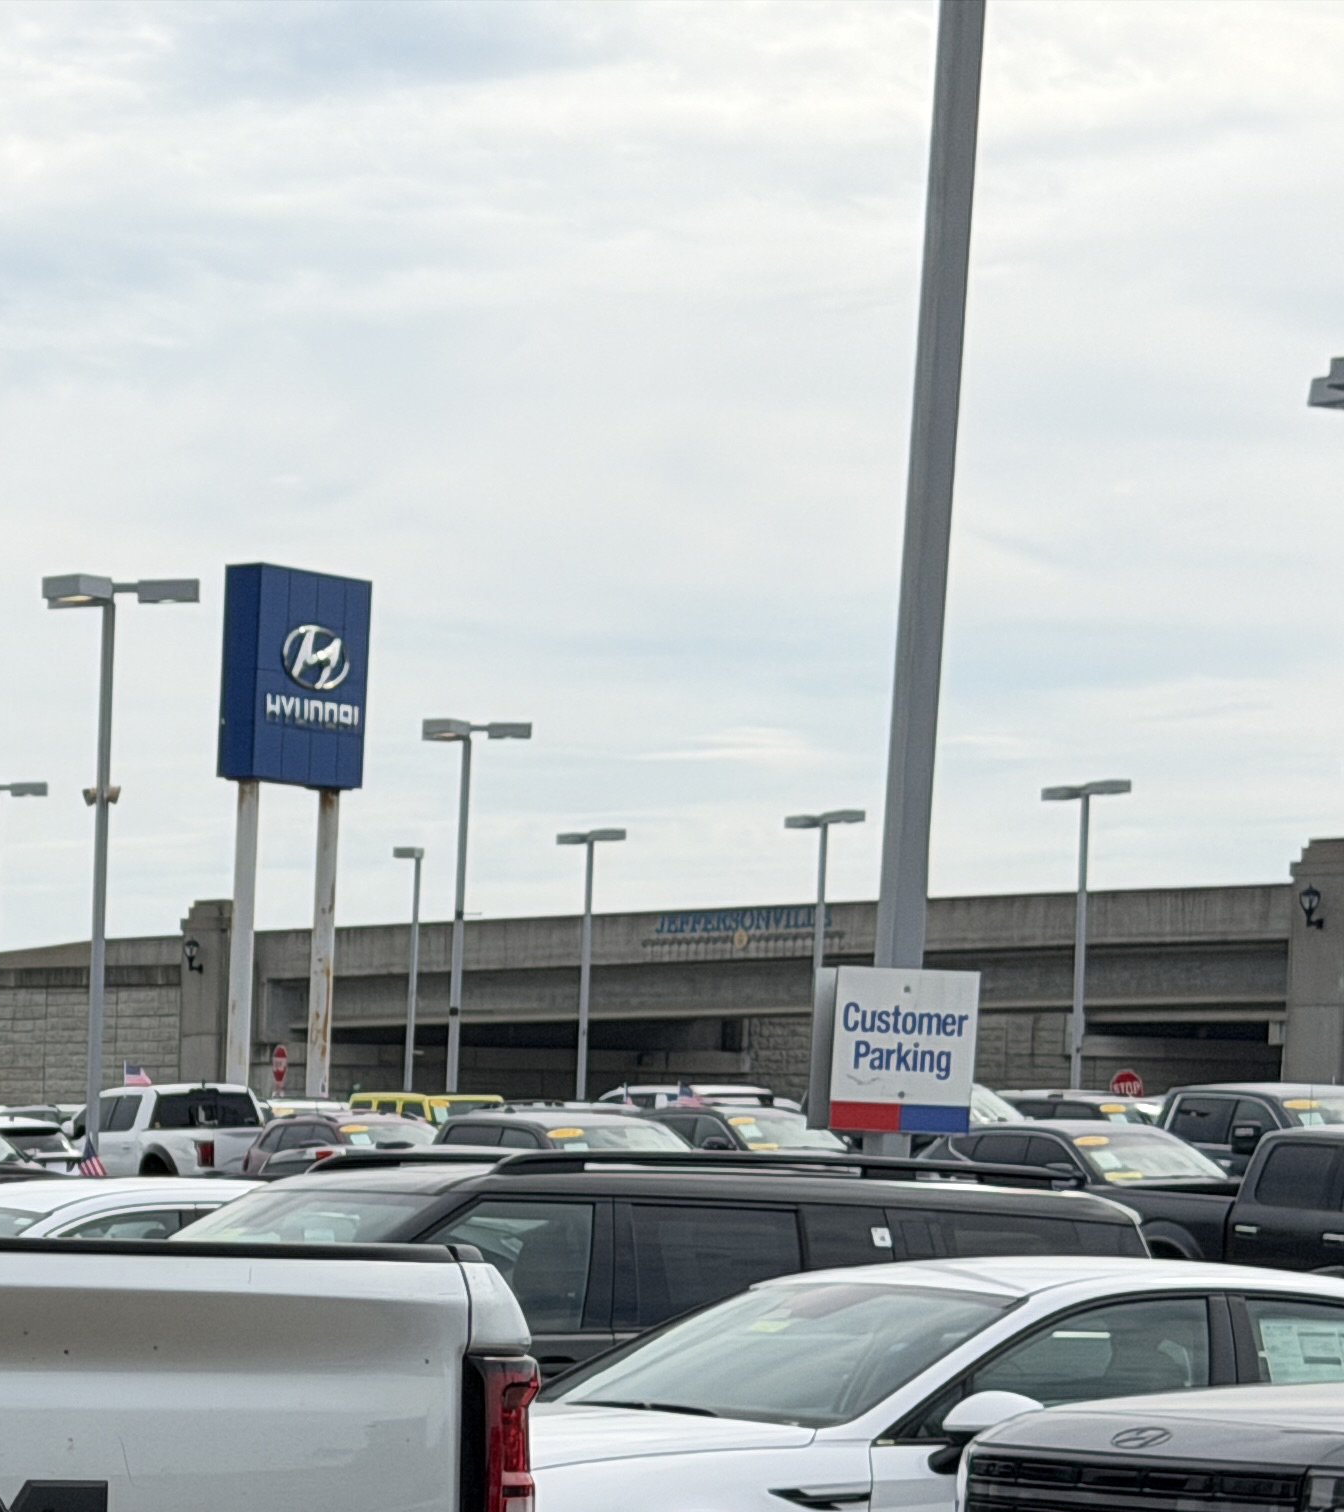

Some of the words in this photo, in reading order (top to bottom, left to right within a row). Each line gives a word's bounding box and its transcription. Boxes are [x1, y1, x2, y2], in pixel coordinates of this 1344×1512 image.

[266, 692, 360, 726] HYUNDAI
[843, 1001, 969, 1037] Customer
[853, 1040, 952, 1080] Parking
[1113, 1081, 1141, 1096] STOP
